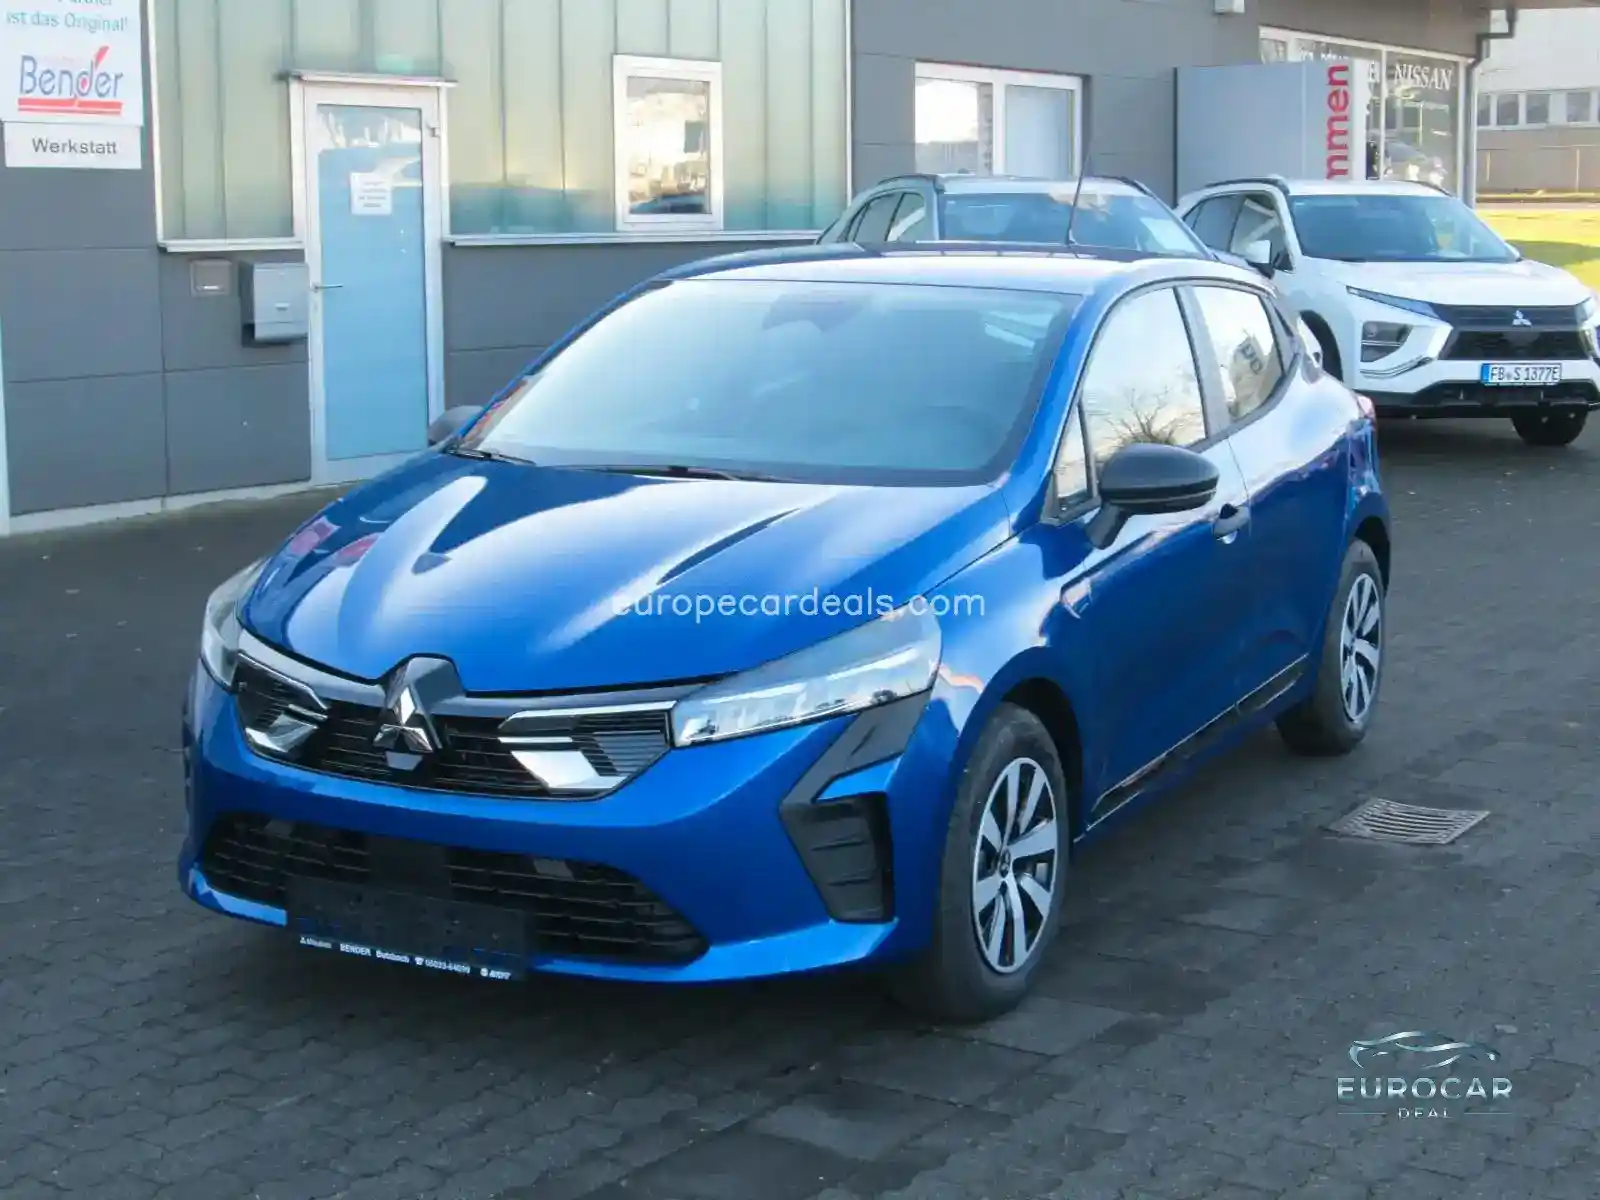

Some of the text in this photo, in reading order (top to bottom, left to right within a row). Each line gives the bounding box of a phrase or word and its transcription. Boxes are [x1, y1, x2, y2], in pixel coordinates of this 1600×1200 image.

[31, 11, 59, 28] das
[20, 46, 123, 99] Bender
[1395, 63, 1452, 90] NISSAN
[32, 138, 117, 154] Werkstatt
